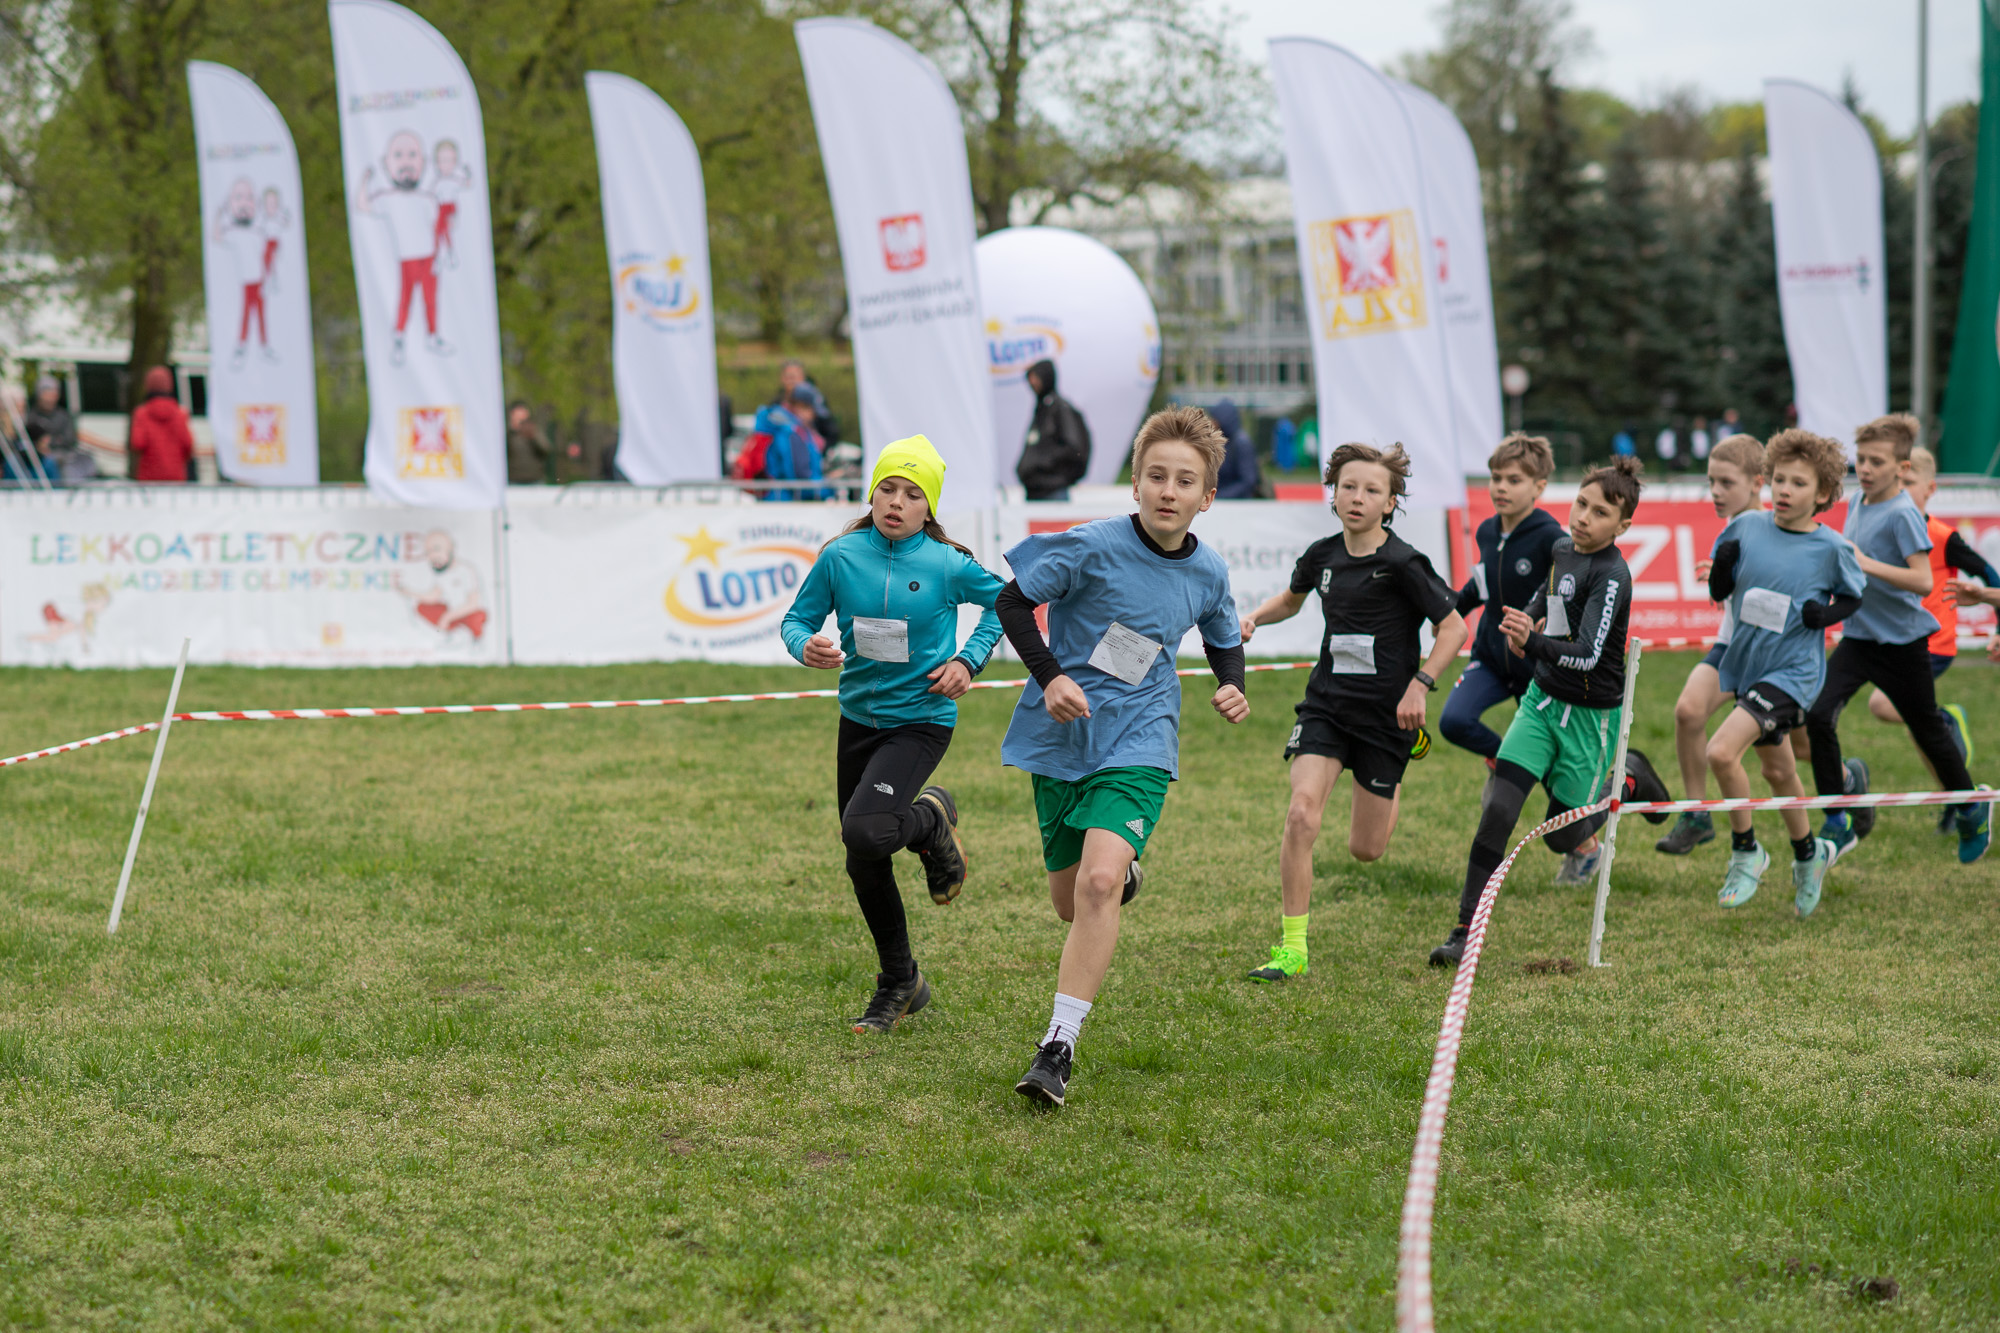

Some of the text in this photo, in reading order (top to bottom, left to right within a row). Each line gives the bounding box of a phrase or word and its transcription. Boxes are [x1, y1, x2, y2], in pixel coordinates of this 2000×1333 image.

[31, 532, 426, 564] LEKKOATLETYCZNE
[103, 570, 235, 591] NADZIEJE
[697, 562, 797, 609] LOTTO
